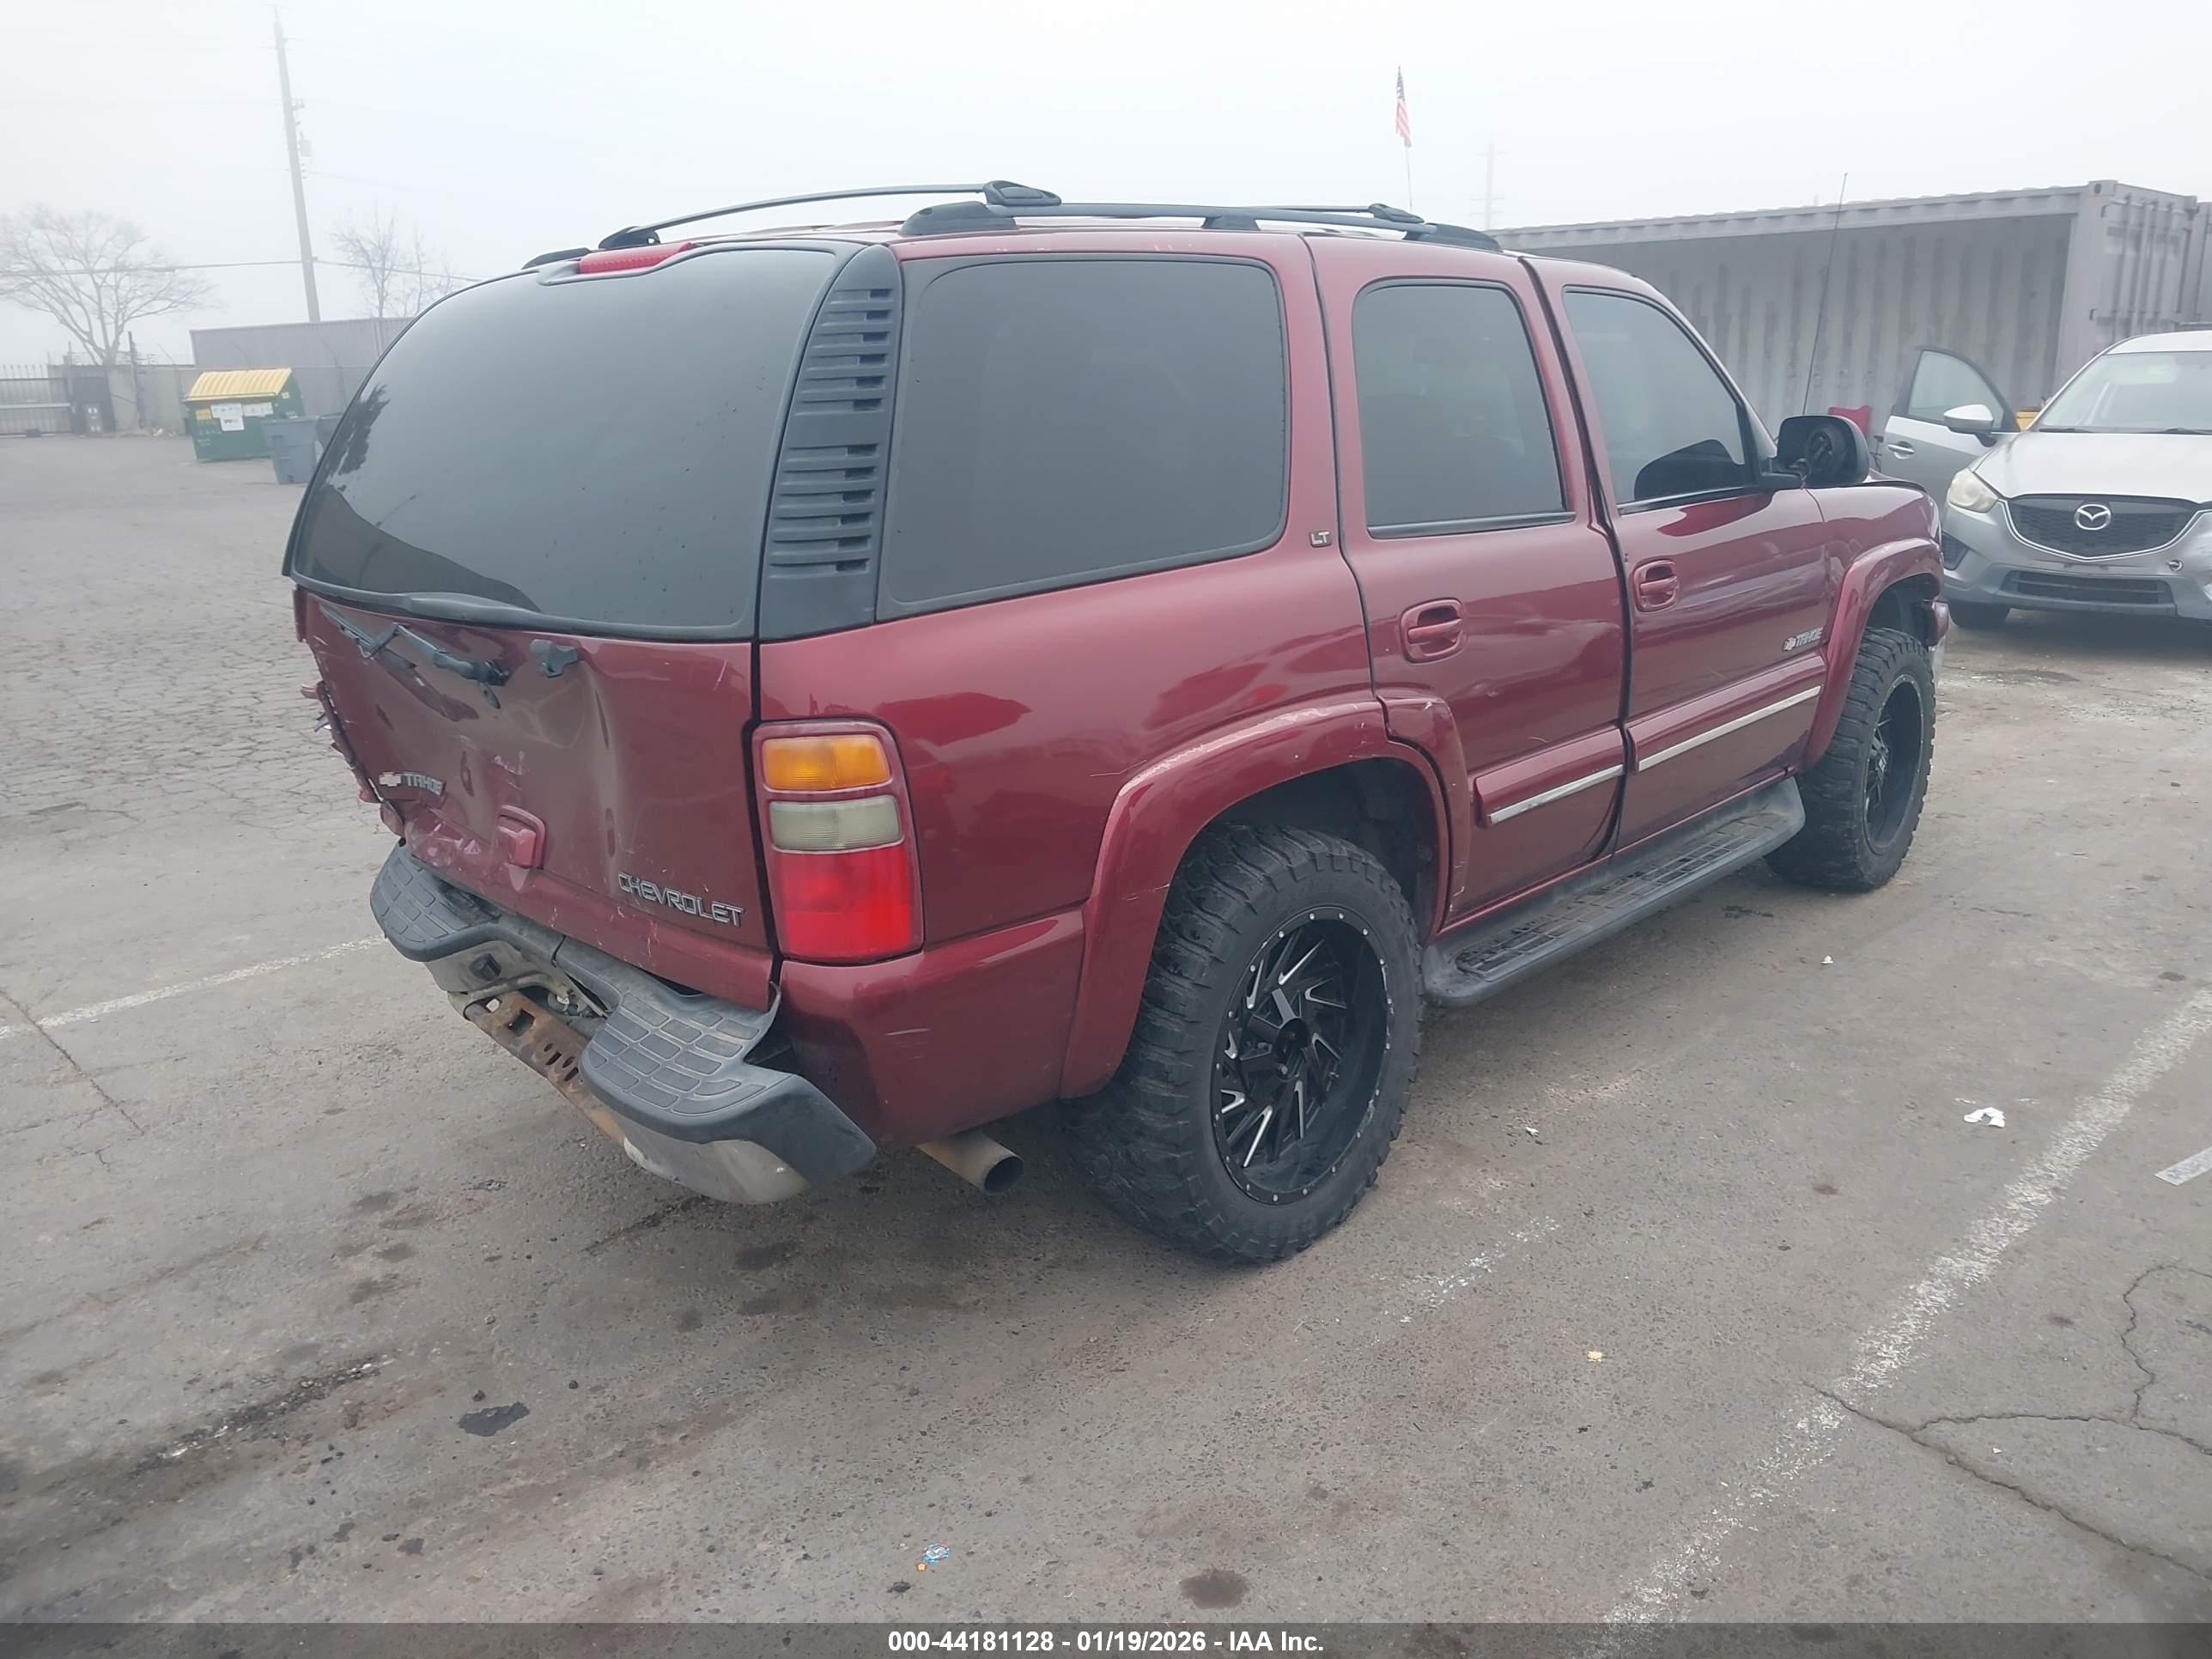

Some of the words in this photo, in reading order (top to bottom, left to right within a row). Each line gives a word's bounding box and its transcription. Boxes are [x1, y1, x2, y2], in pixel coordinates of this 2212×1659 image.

[1310, 531, 1330, 544] LT
[1796, 626, 1823, 647] TAHOE
[403, 772, 441, 796] TAHOE
[617, 872, 744, 927] CHEVROLET
